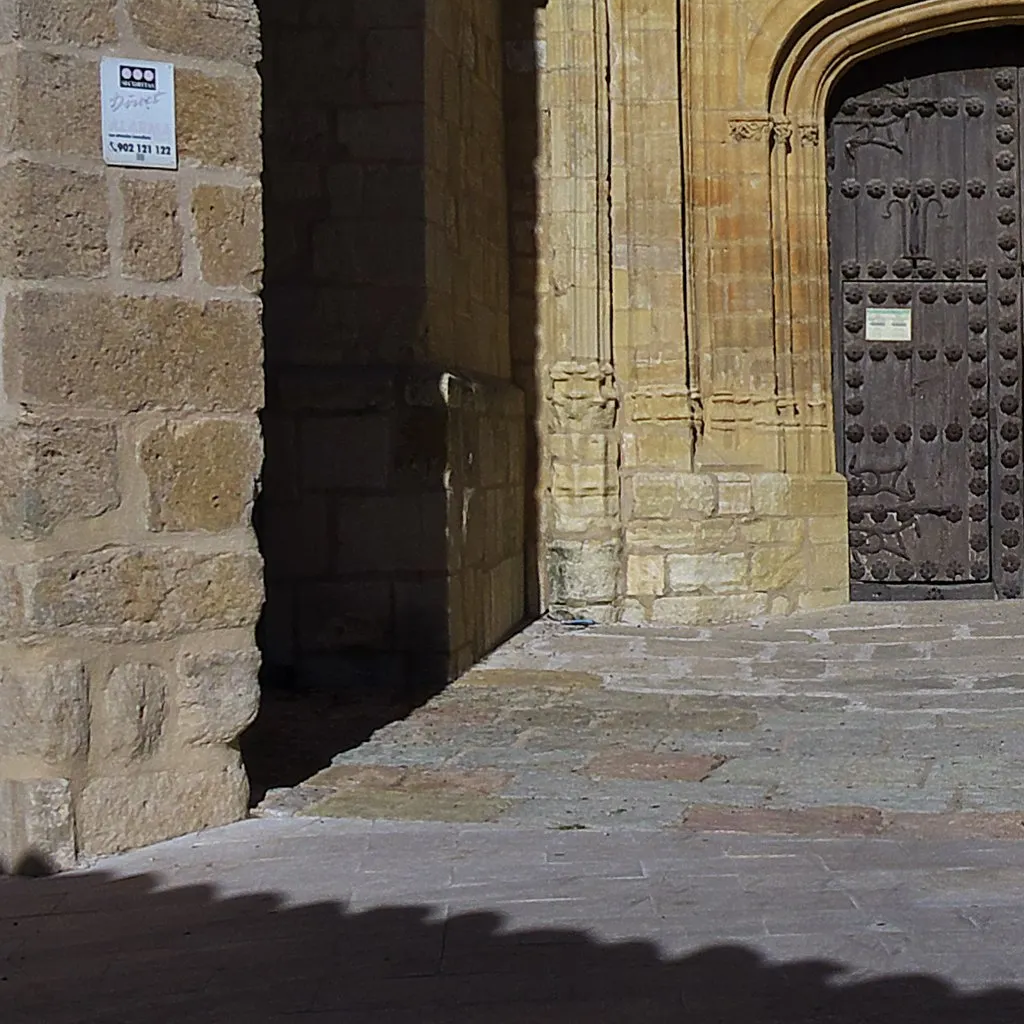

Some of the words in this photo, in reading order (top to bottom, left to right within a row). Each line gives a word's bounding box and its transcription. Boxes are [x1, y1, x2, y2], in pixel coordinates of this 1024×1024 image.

[117, 143, 134, 153] 902
[137, 144, 152, 154] 121
[155, 145, 171, 155] 122
